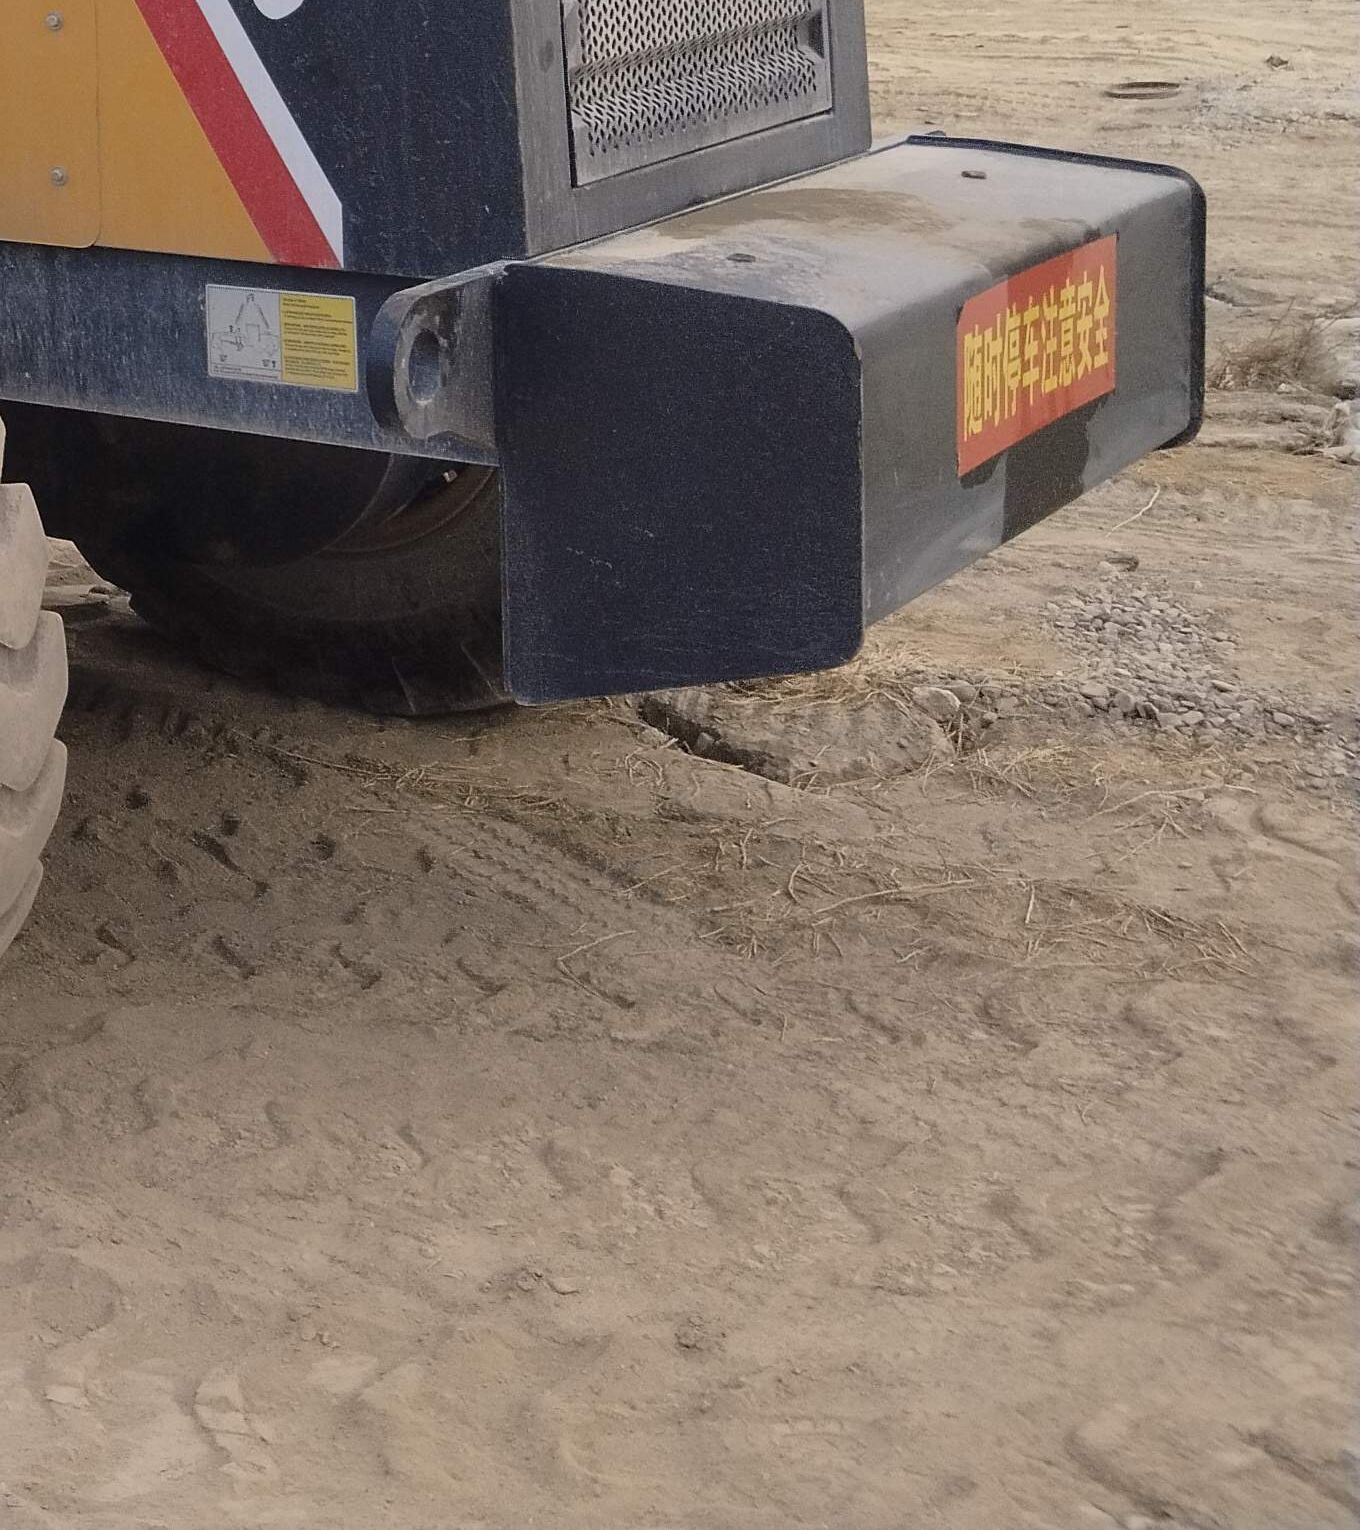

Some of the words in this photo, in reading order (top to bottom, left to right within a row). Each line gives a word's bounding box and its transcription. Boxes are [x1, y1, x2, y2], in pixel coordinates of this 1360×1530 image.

[964, 265, 1110, 442] 随时停车注意安全
